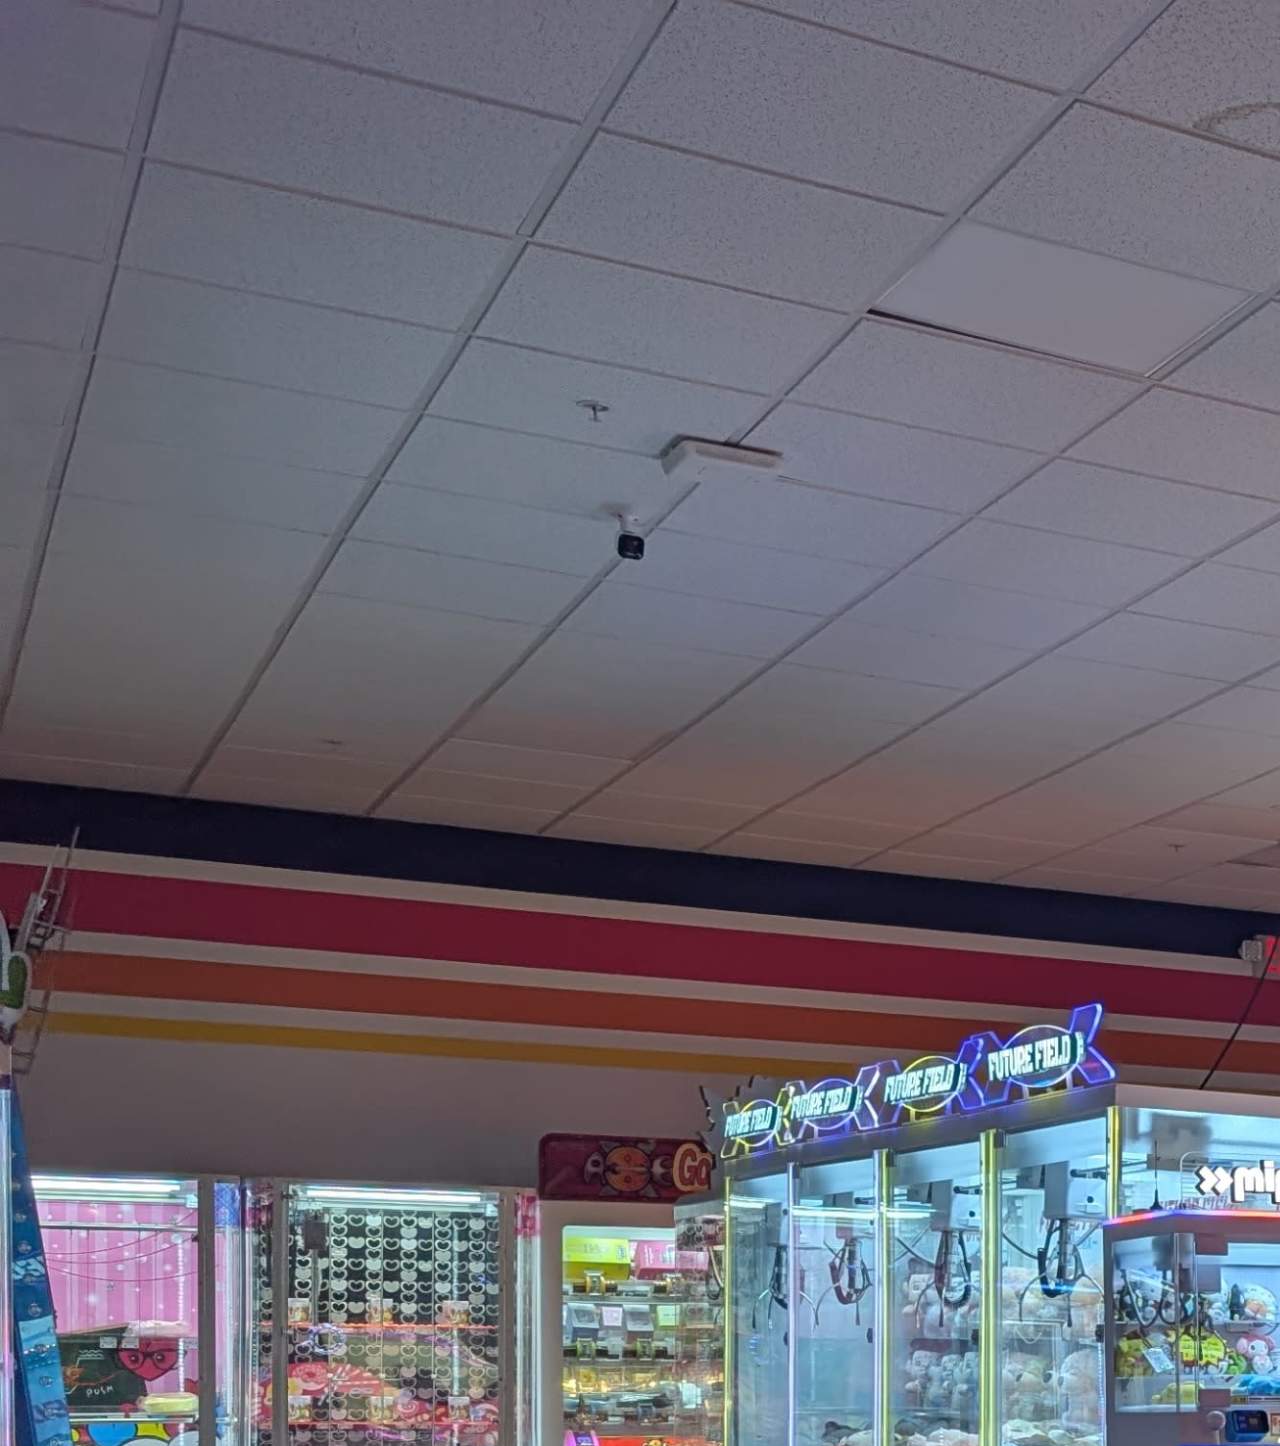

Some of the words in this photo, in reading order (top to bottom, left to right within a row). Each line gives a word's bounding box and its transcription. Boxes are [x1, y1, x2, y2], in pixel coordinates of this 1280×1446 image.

[987, 1044, 1035, 1081] FUTURE
[1035, 1035, 1071, 1073] FIELD
[884, 1070, 924, 1103] FUTURE
[922, 1064, 954, 1095] FIELD
